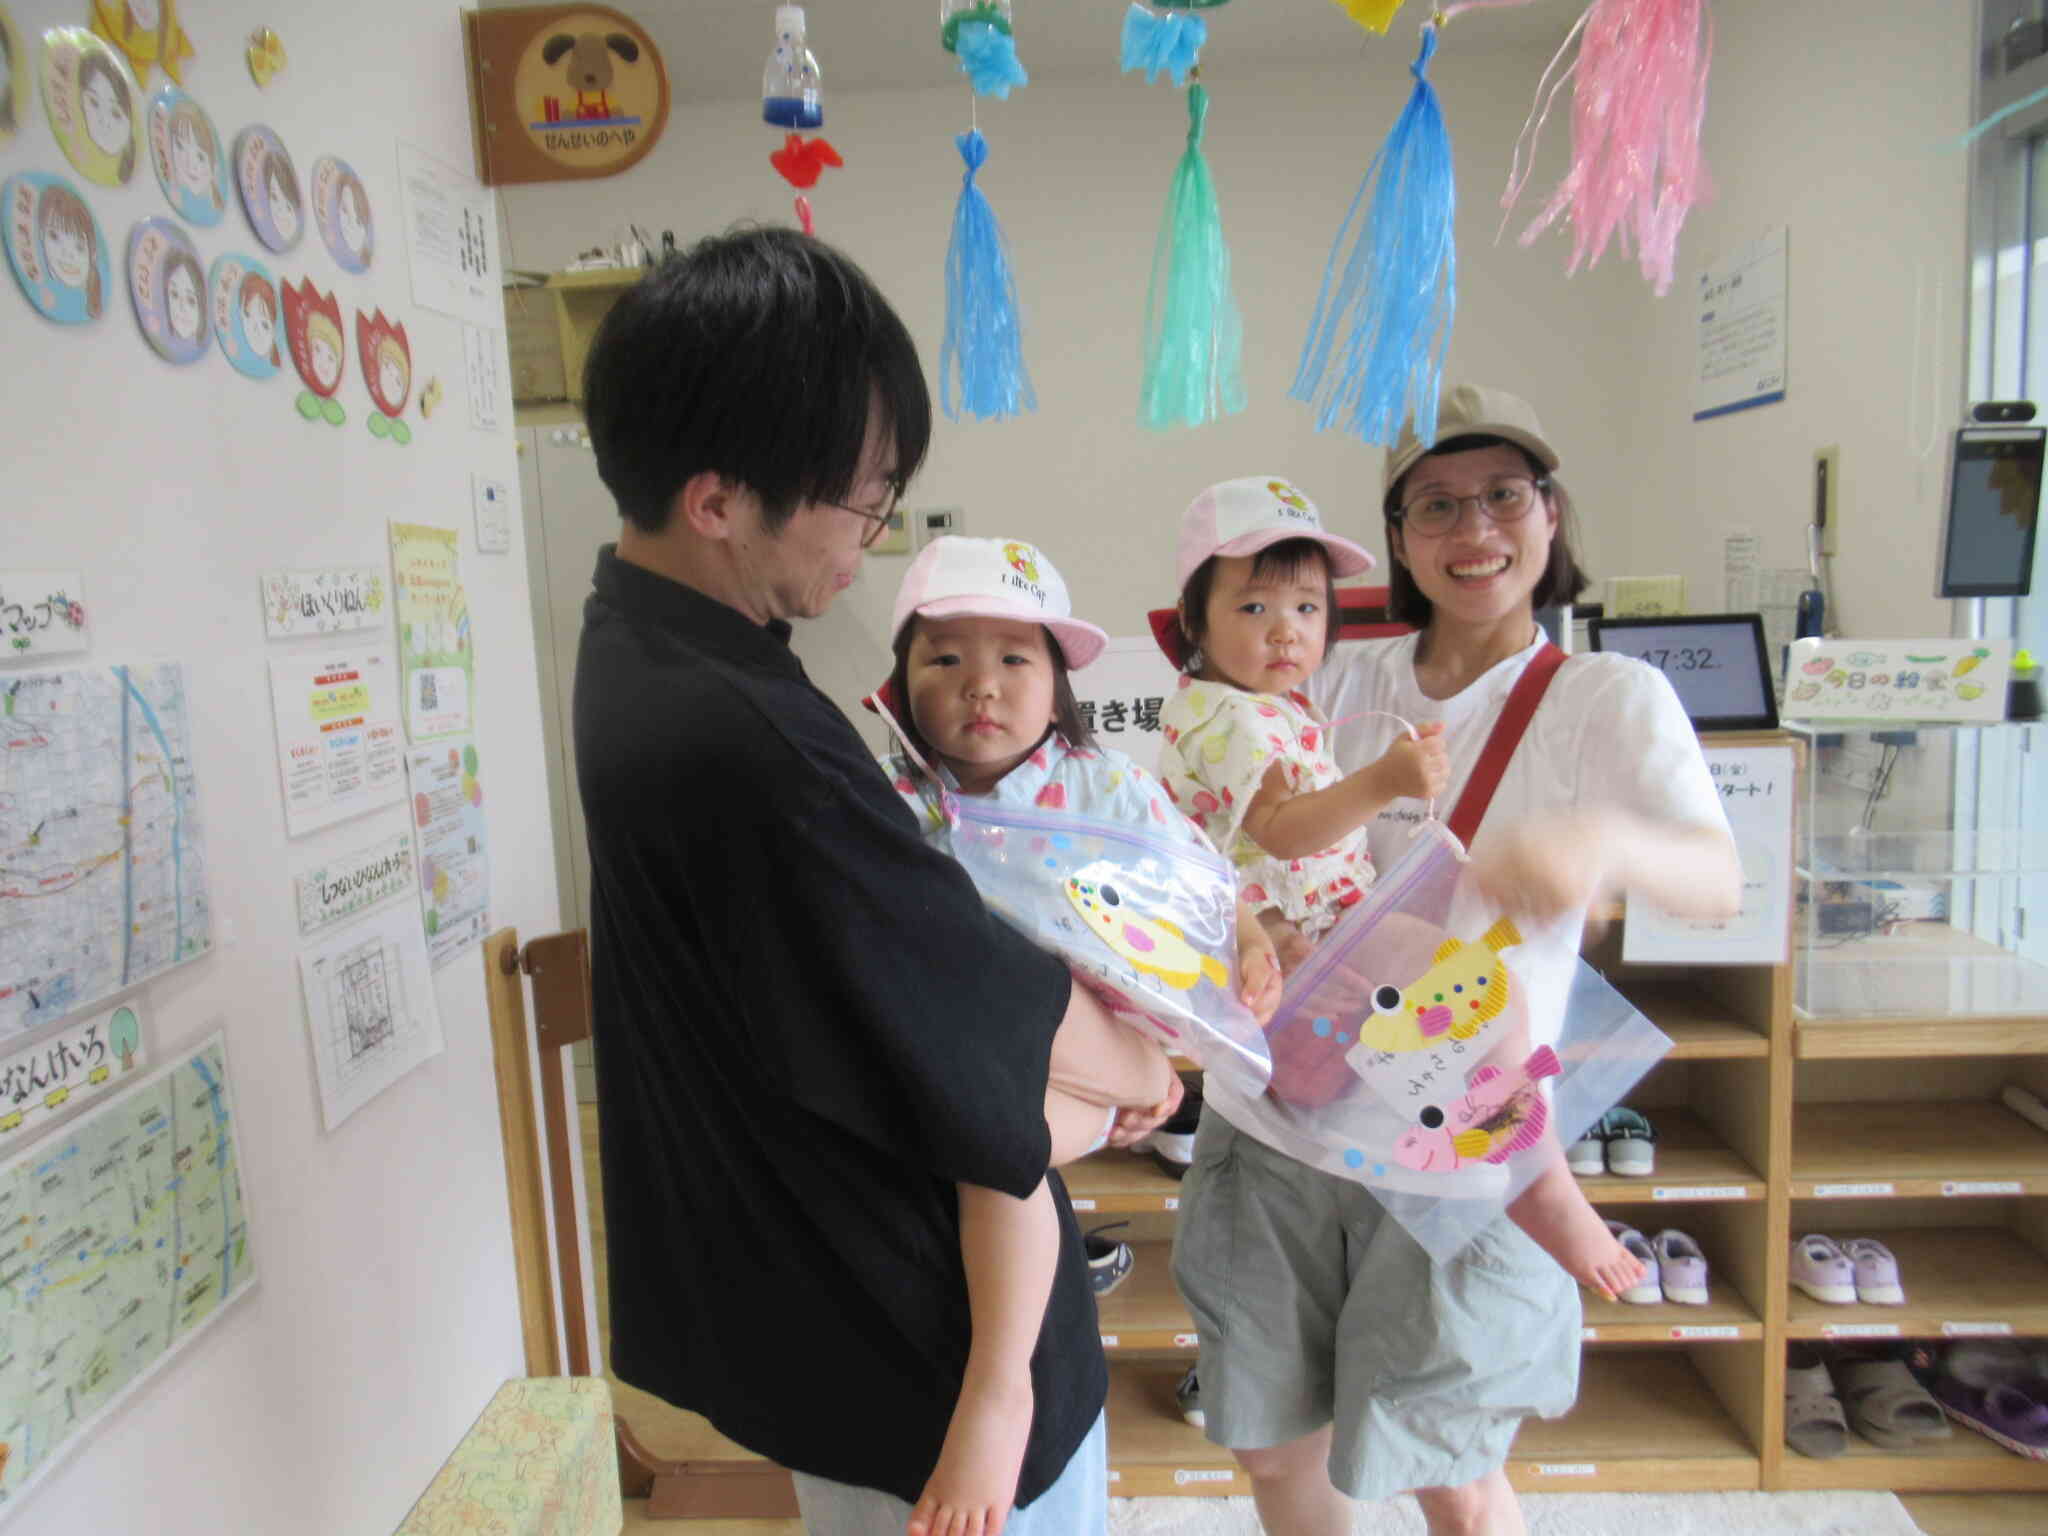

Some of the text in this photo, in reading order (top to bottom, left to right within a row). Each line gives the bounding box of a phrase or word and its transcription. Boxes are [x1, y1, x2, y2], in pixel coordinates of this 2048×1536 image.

[545, 127, 635, 150] せんせいのへや
[0, 594, 53, 635] マップ
[1640, 647, 1713, 671] 17:32
[0, 1024, 105, 1104] なんけいろ
